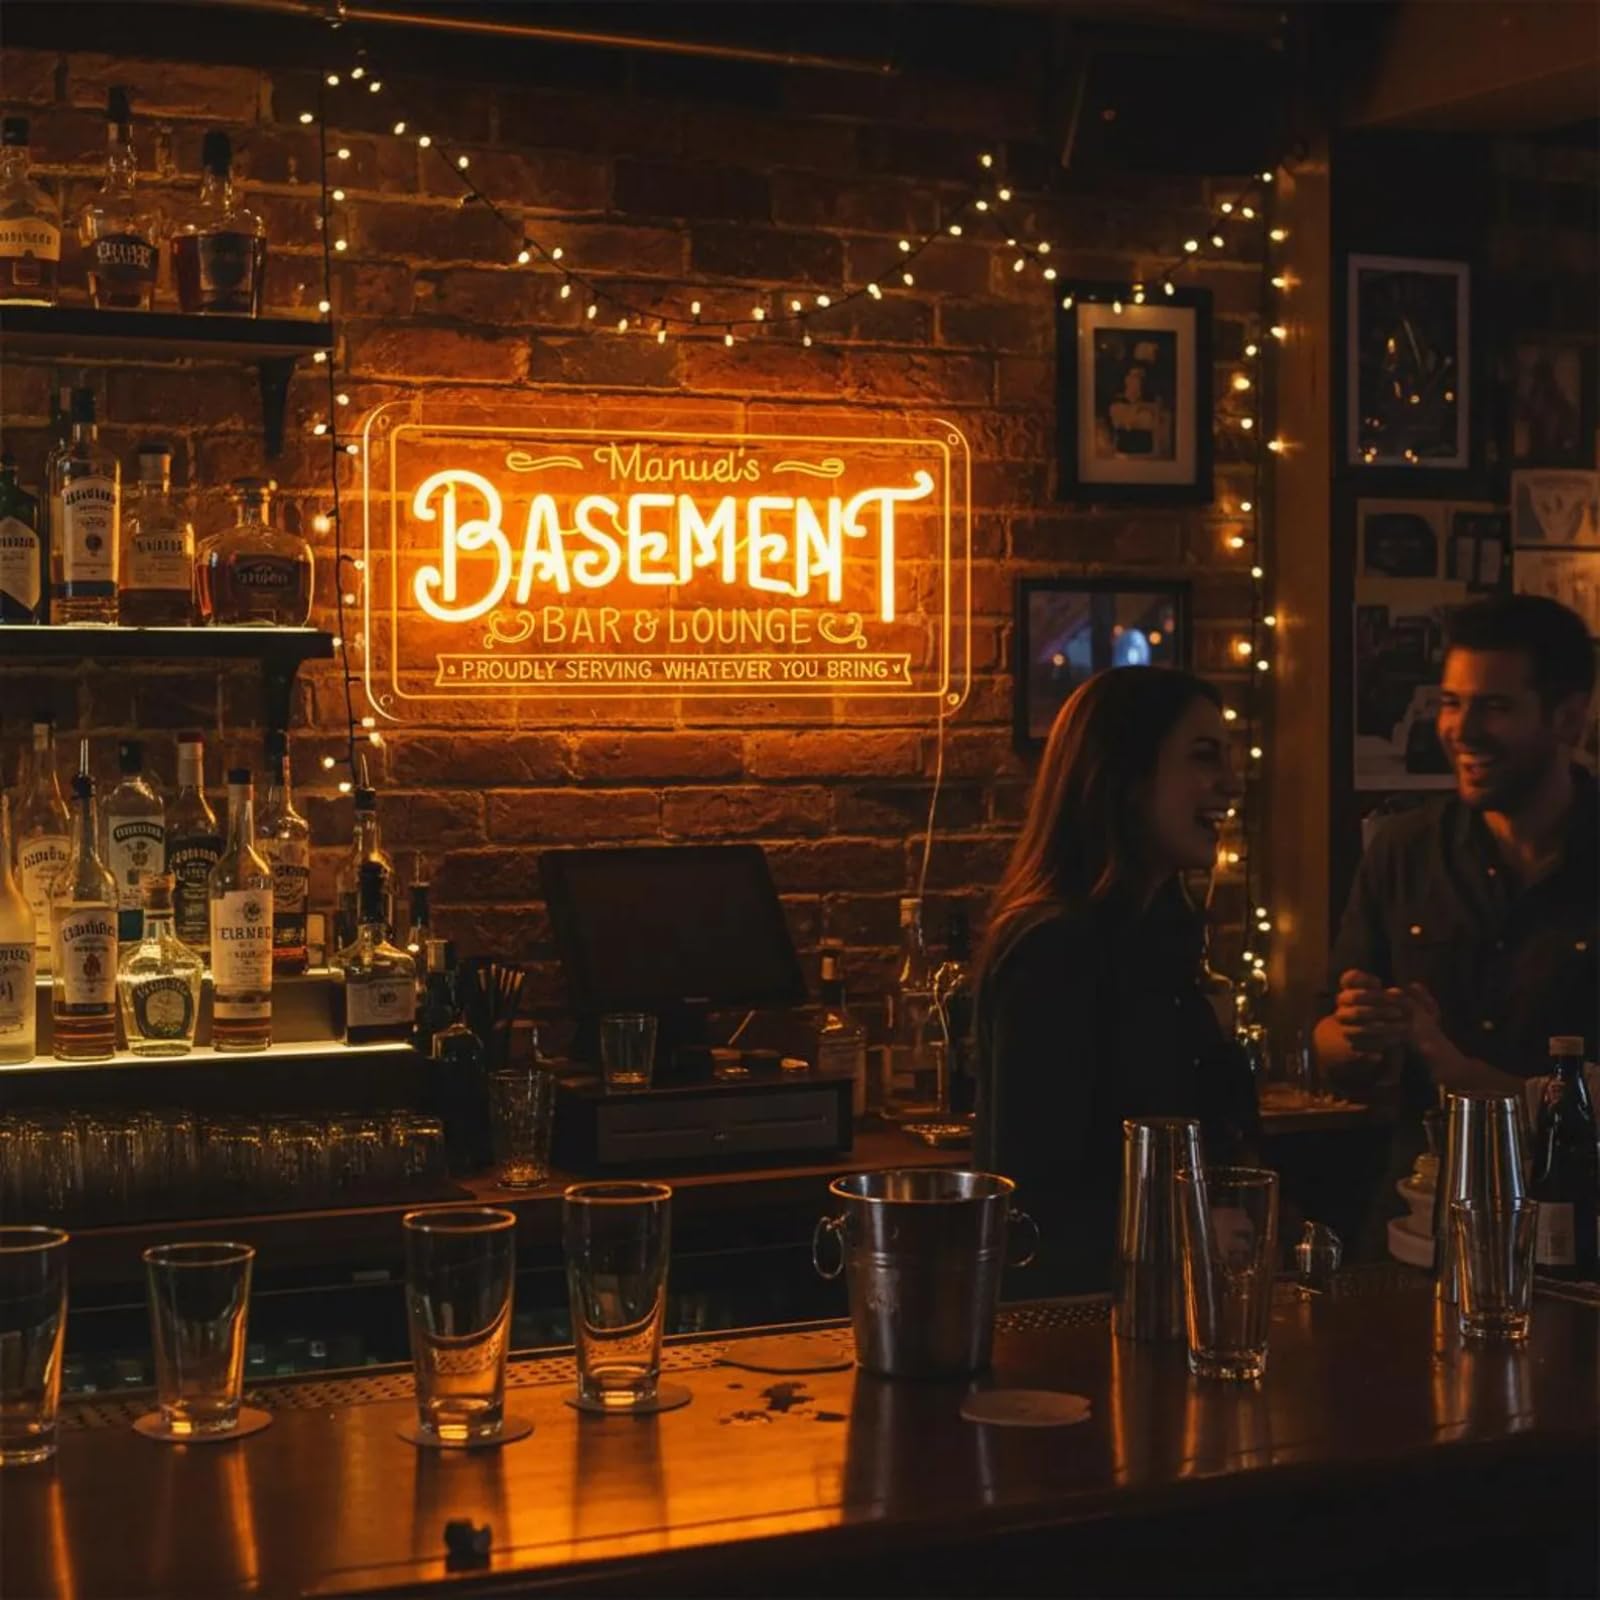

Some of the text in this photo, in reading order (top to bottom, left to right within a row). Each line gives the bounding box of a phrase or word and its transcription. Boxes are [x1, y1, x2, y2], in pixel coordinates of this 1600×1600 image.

[594, 442, 761, 483] Manuel's
[413, 469, 934, 622] BASEMENT
[543, 607, 813, 645] BAR & LOUNGE
[461, 659, 888, 680] PROUDLY SERVING WHATEVER YOU BRING
